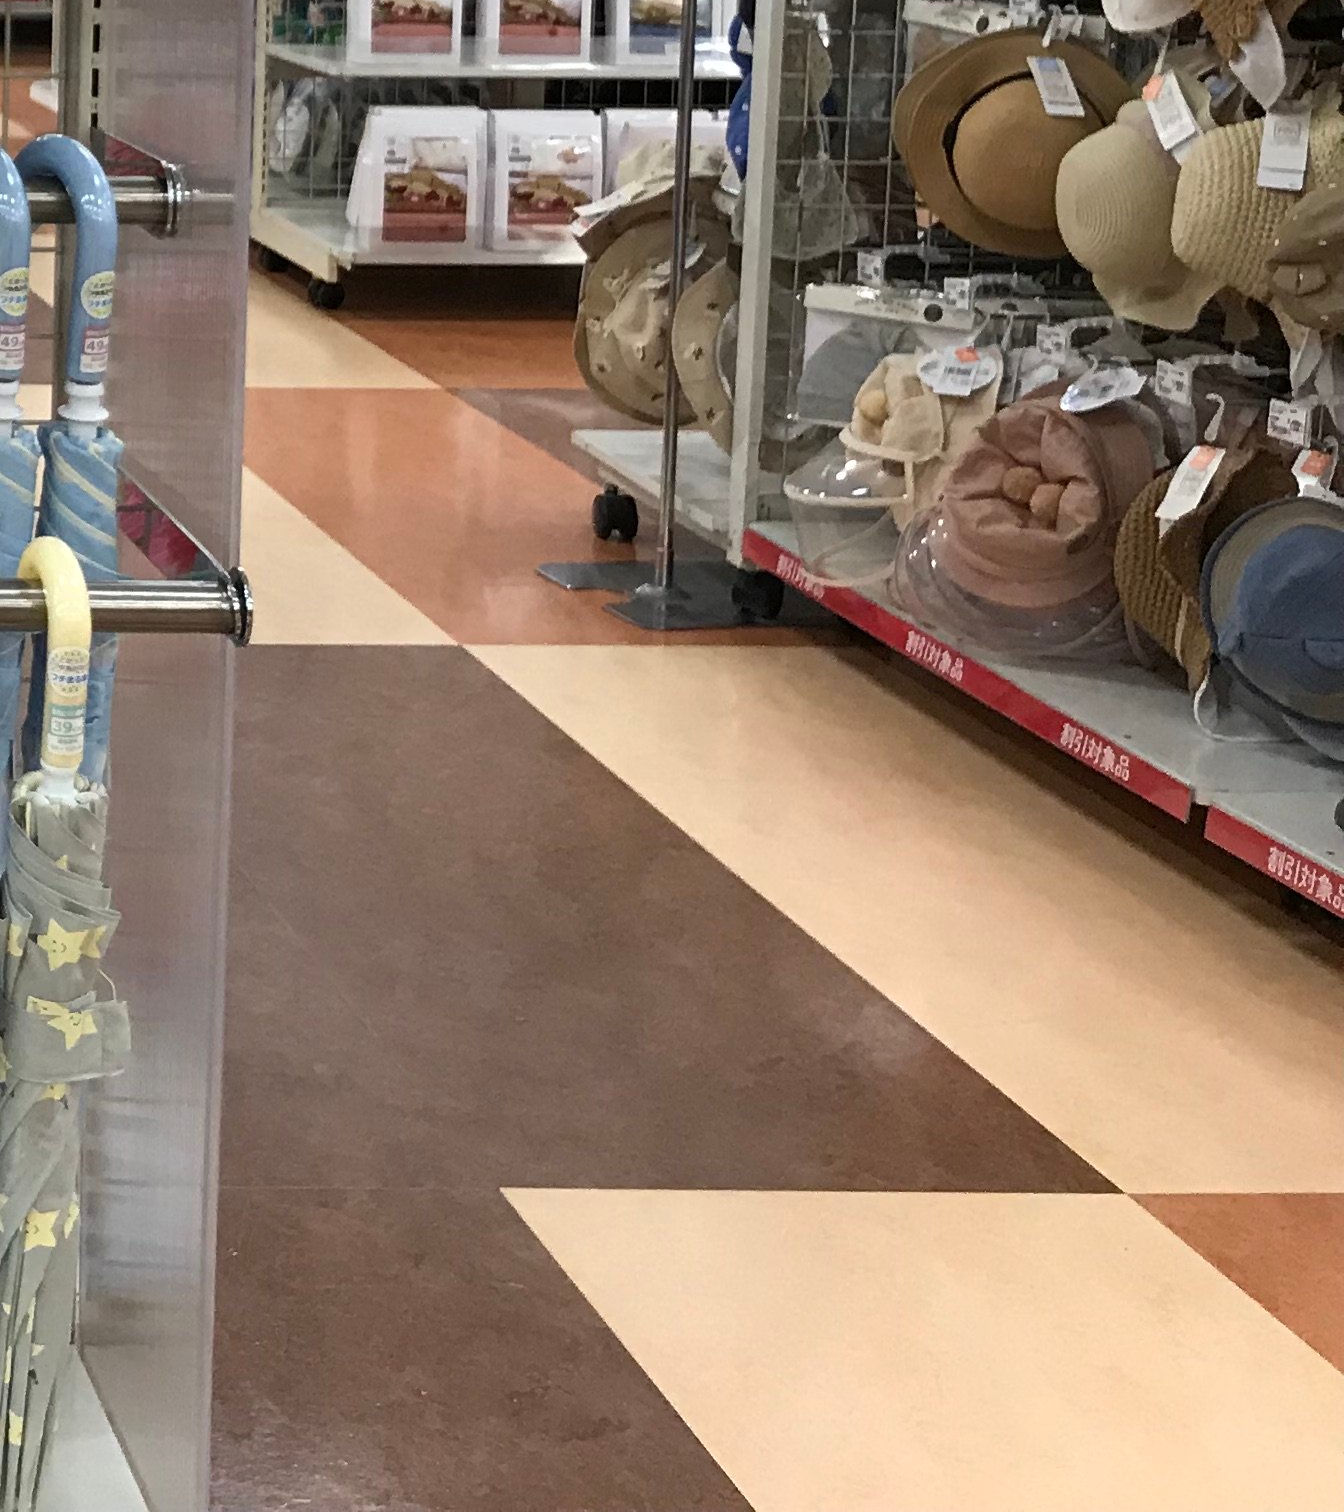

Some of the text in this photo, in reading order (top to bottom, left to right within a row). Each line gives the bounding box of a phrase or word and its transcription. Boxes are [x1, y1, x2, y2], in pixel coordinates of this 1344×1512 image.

[1060, 722, 1130, 782] 割引対象品
